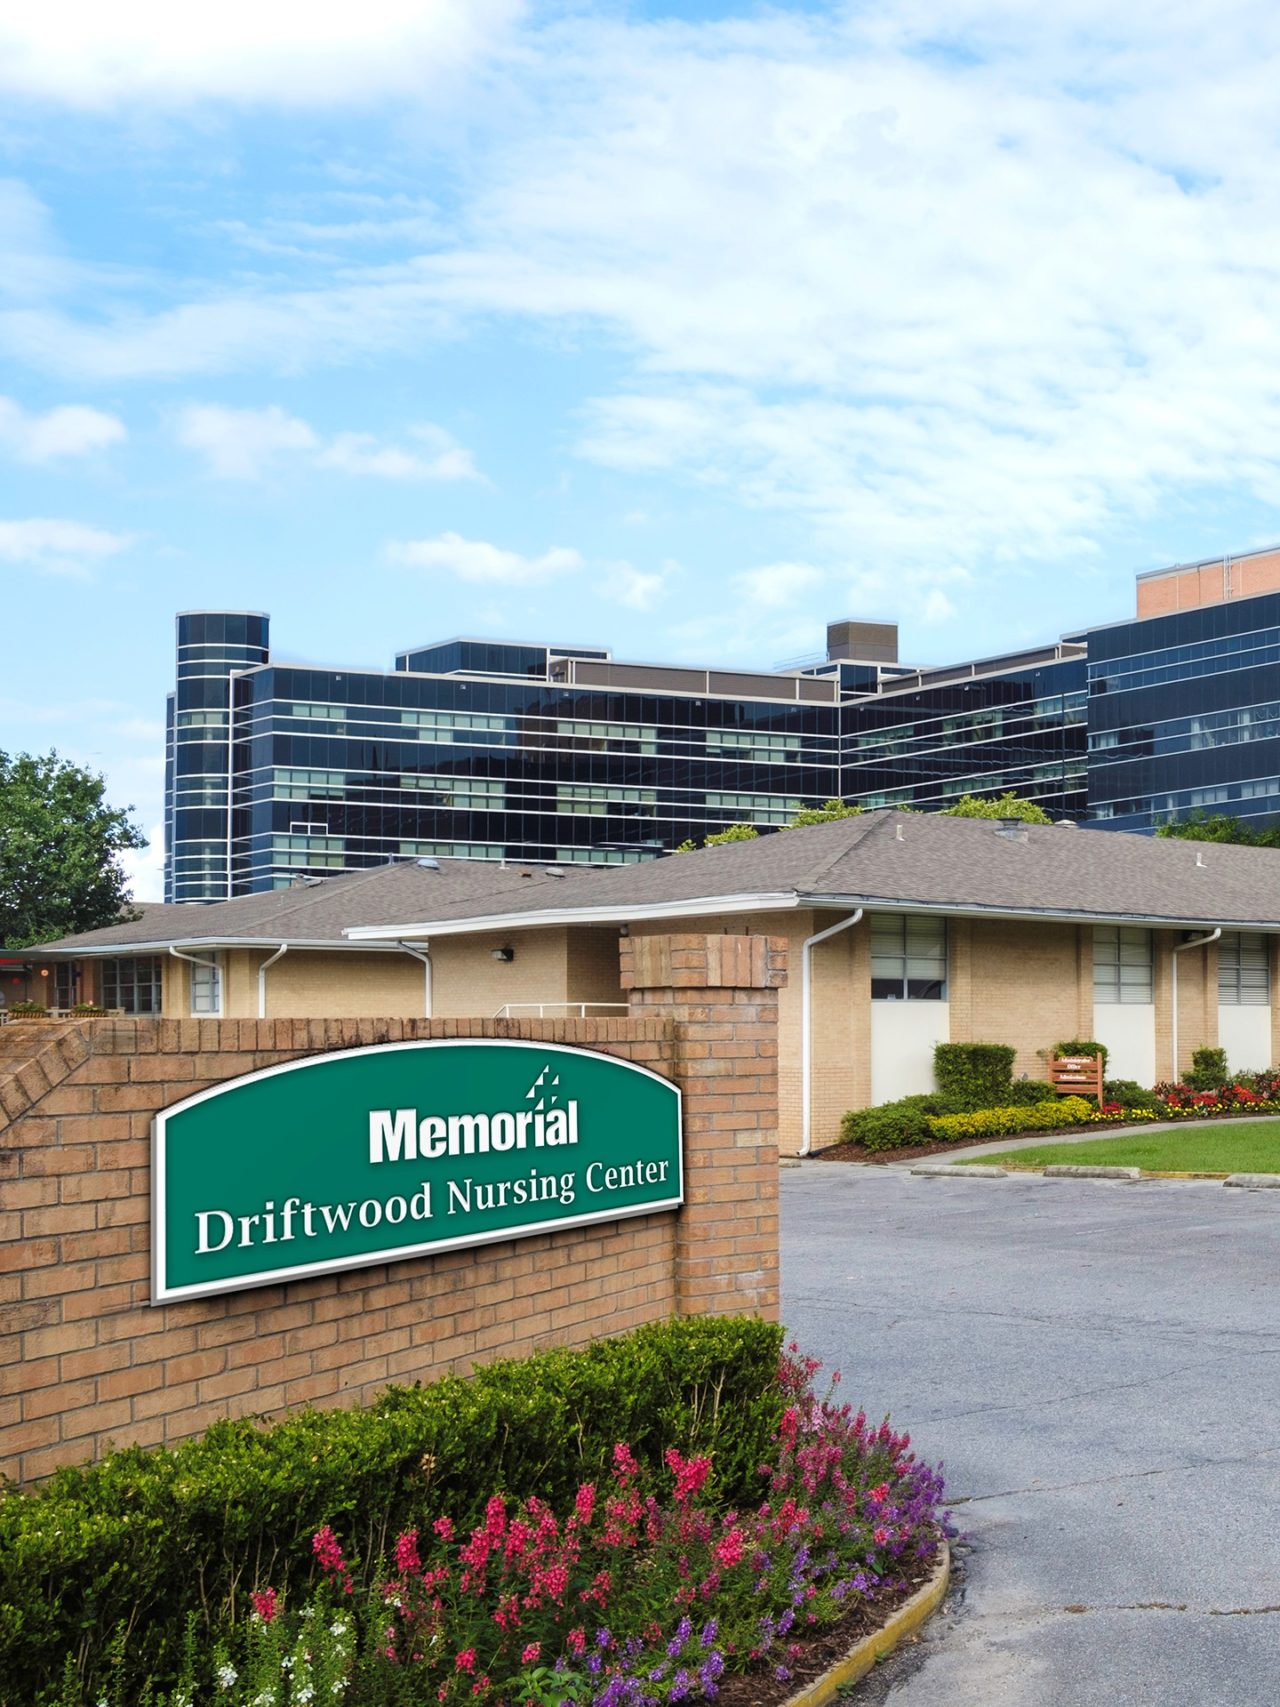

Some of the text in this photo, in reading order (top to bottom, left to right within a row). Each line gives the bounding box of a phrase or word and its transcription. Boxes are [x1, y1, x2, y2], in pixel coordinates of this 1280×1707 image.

[369, 1099, 578, 1164] Memorial
[194, 1160, 670, 1255] Driftwood Nursing Center
